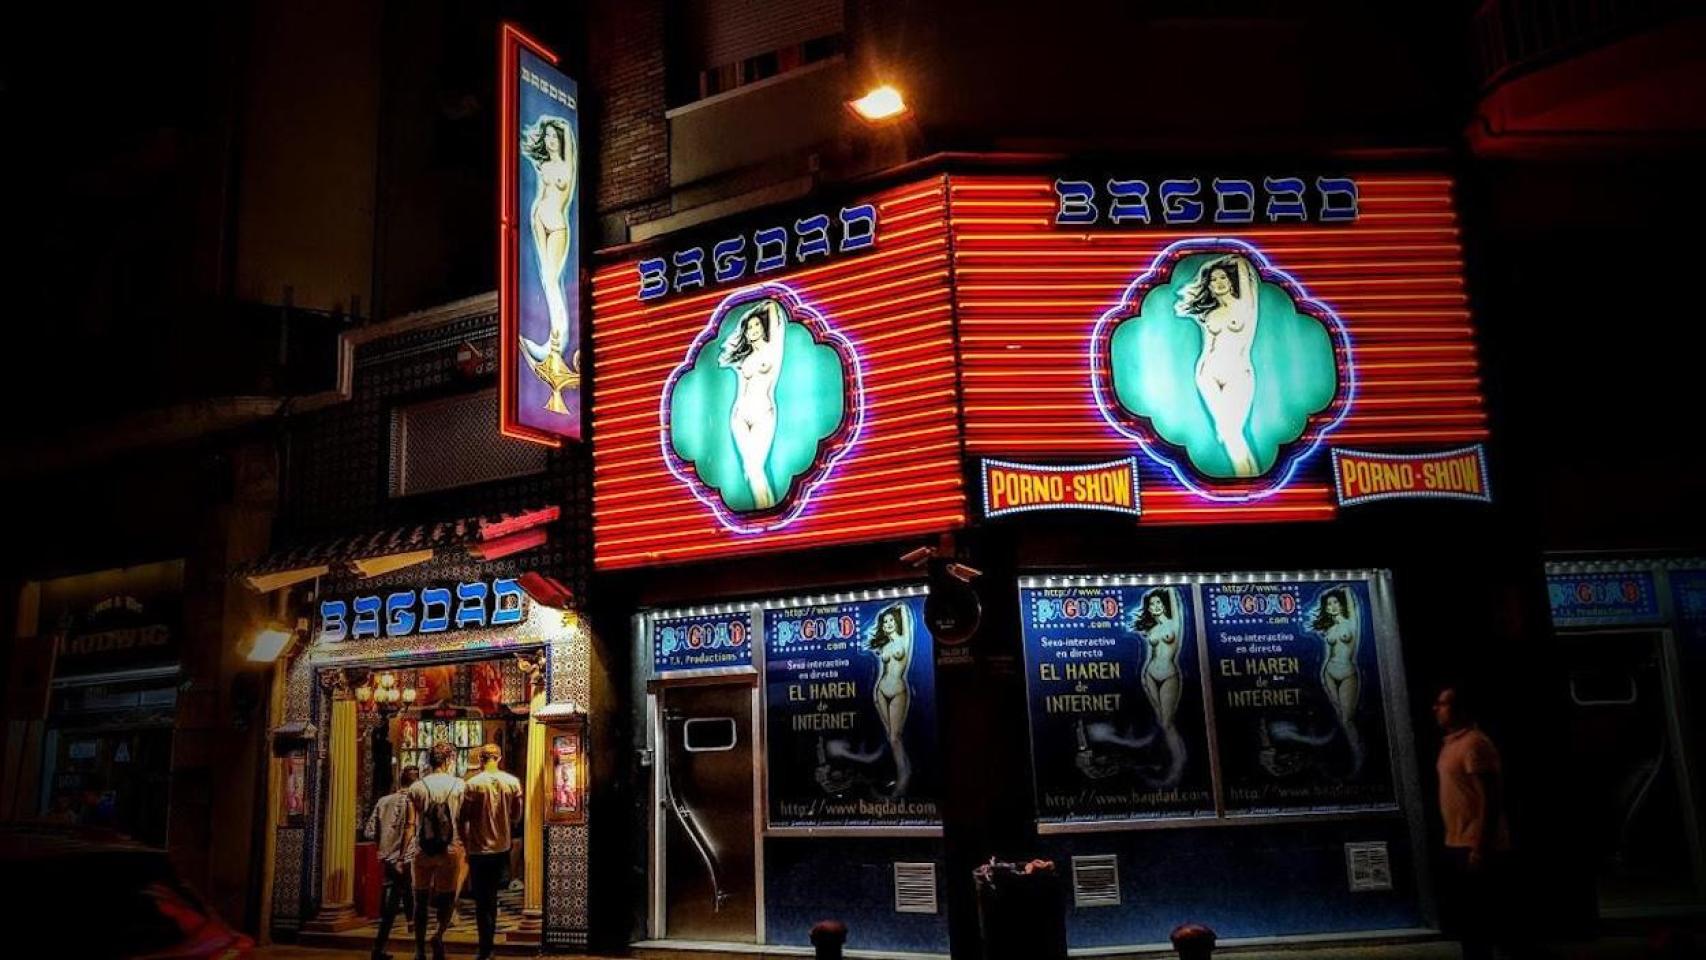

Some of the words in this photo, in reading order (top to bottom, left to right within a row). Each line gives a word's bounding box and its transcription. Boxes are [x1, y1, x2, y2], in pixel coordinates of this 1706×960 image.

[521, 67, 577, 110] BAGDAD
[1055, 177, 1360, 225] BAGDAD
[637, 204, 876, 301] BAGDAD
[320, 578, 524, 643] BAGDAD
[1037, 598, 1120, 623] BAGDAD
[1216, 594, 1297, 619] BAGDAD
[661, 621, 746, 657] BAGDAD
[778, 616, 855, 647] BAGDAD
[1069, 648, 1104, 659] directo
[1040, 663, 1062, 681] EL
[1065, 661, 1120, 681] HAREN
[1220, 659, 1243, 677] EL
[1245, 657, 1299, 676] HAREN
[789, 685, 807, 702] EL
[810, 682, 856, 700] HAREN
[1074, 681, 1089, 692] de
[1046, 694, 1121, 713] INTERNET
[1228, 688, 1299, 708] INTERNET
[792, 712, 857, 731] INTERNET
